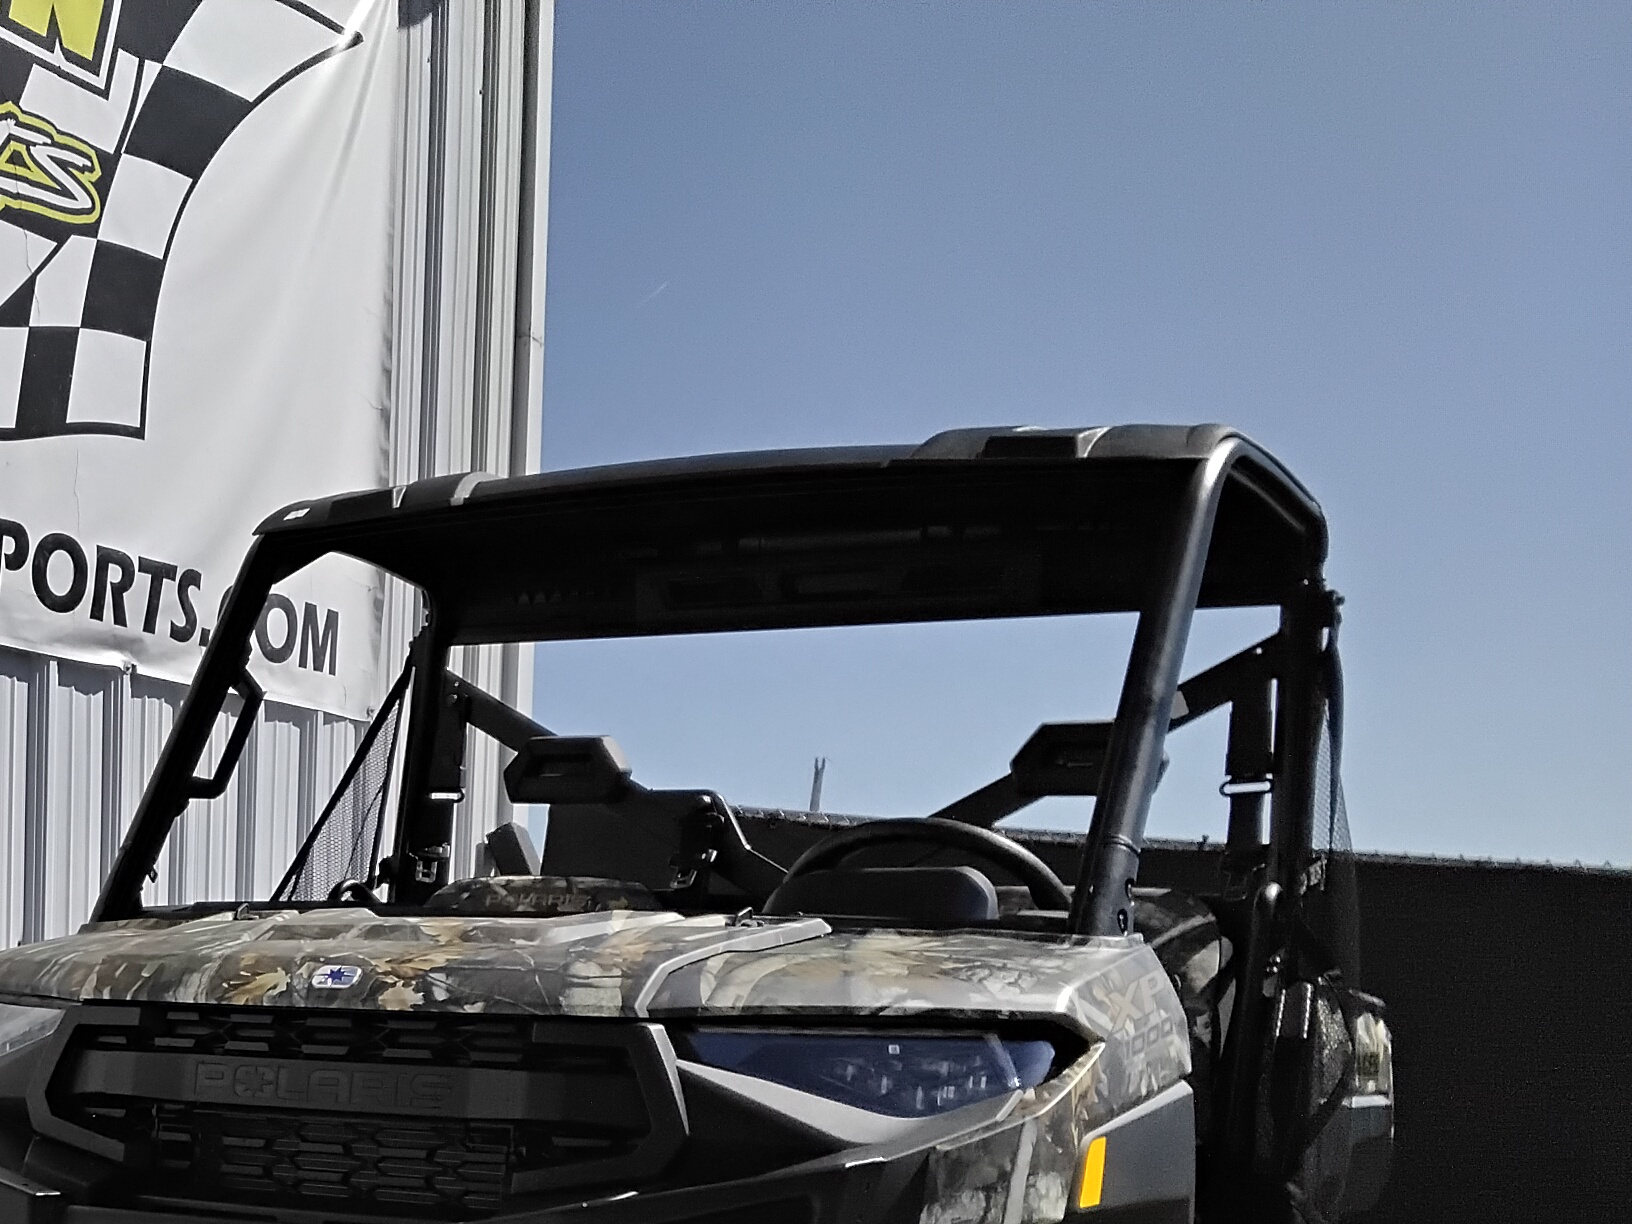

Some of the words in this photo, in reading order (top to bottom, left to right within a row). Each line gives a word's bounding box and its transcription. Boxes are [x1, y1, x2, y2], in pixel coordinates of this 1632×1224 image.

[1110, 970, 1167, 1034] XP
[1121, 1016, 1175, 1065] 1000
[194, 1061, 453, 1109] POLARIS
